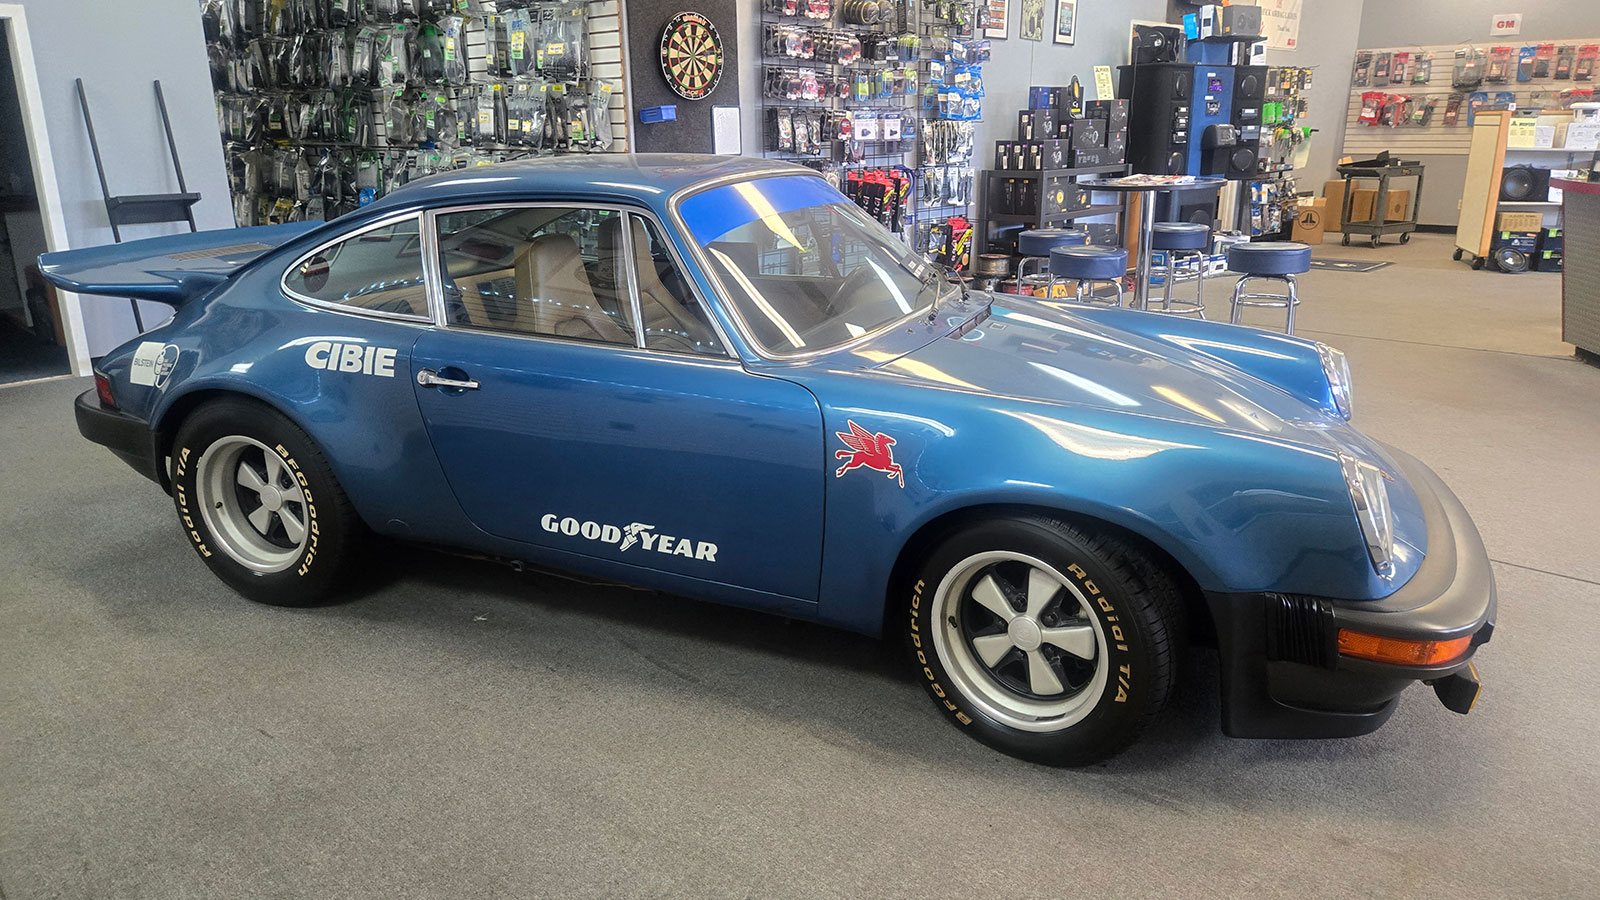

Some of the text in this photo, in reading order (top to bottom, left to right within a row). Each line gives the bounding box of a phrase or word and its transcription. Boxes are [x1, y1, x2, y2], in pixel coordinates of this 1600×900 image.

[1496, 20, 1515, 29] GM
[304, 341, 398, 378] CIBIE
[176, 447, 212, 558] Radial T/A
[275, 443, 321, 577] BFGoodrich
[909, 578, 973, 727] BFGoodrich
[1066, 563, 1132, 703] Radial T/A
